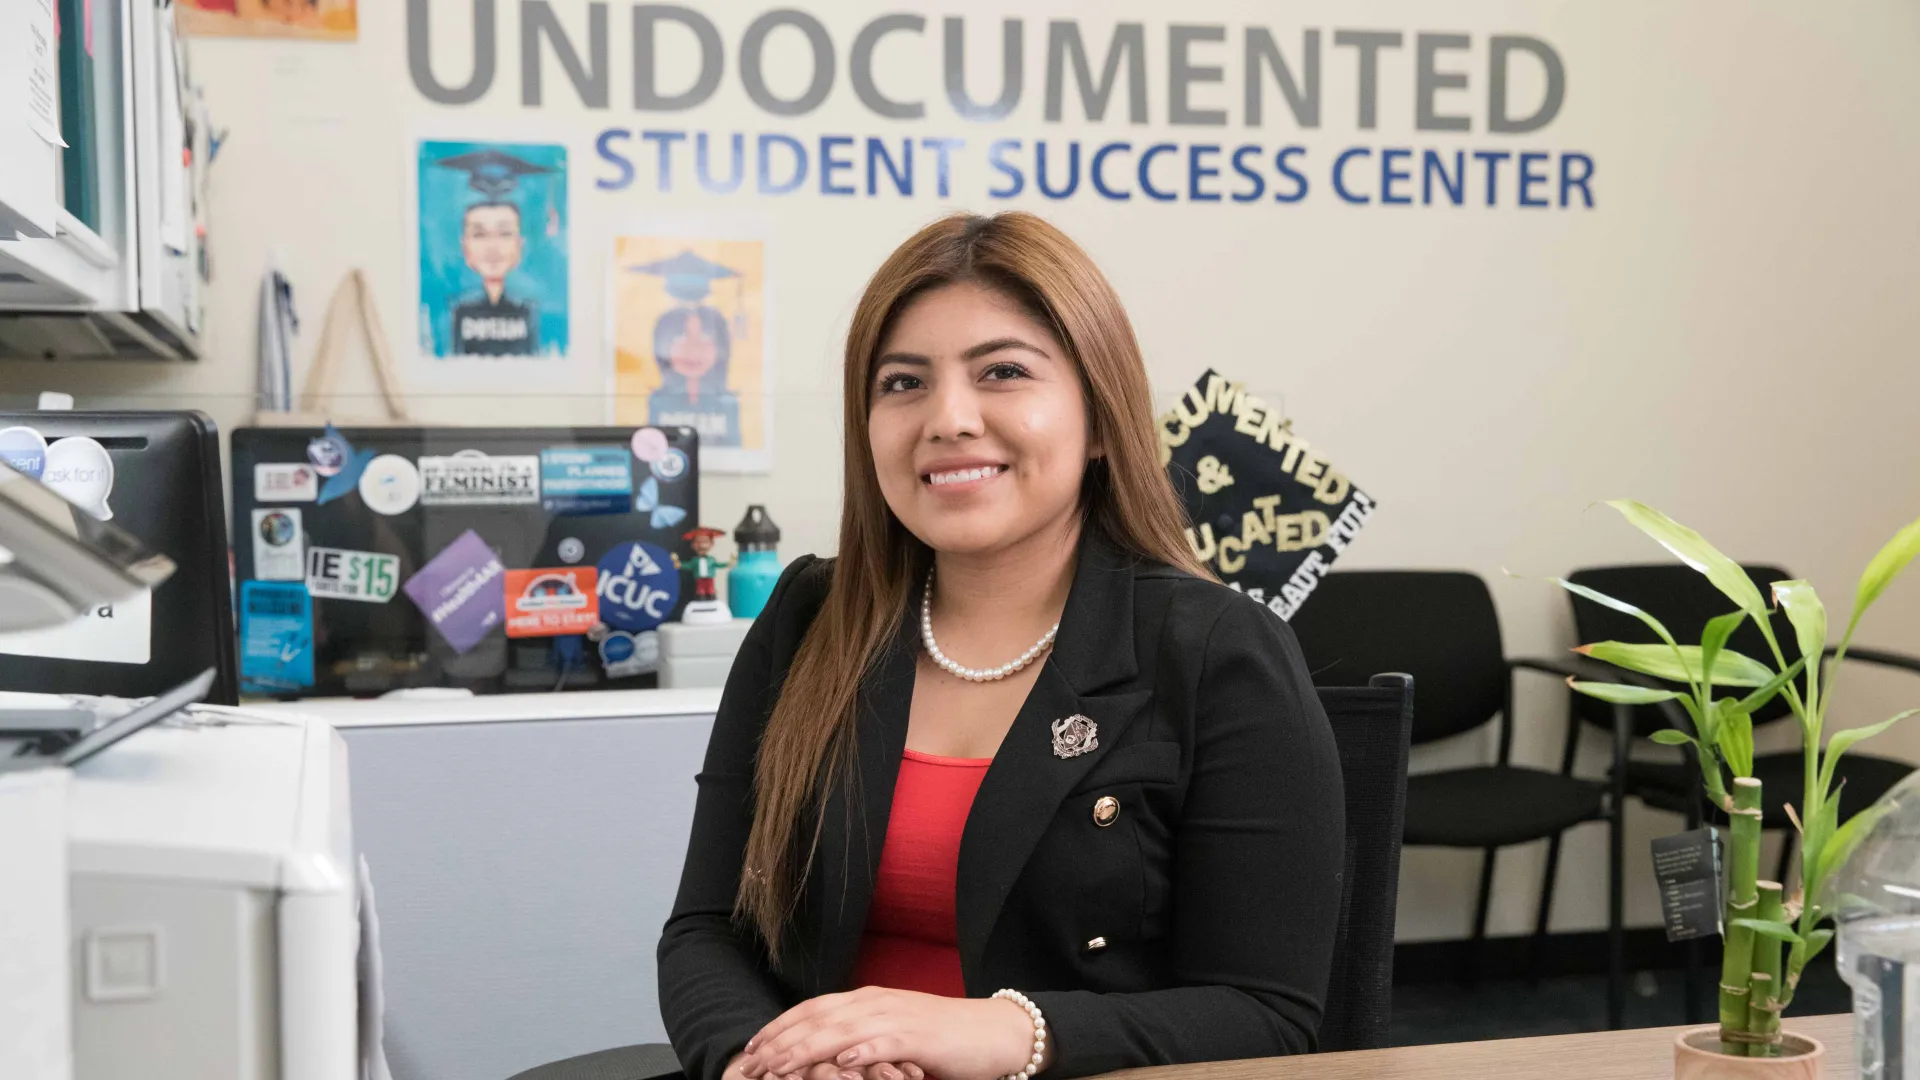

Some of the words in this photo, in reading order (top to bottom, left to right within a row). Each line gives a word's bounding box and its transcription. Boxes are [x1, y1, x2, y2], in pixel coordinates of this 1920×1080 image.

[406, 0, 1567, 135] UNDOCUMENTED
[595, 128, 964, 198] STUDENT
[987, 138, 1309, 203] SUCCESS
[1332, 147, 1597, 208] CENTER
[1158, 374, 1349, 504] CUMENTED
[46, 467, 71, 483] ask
[74, 466, 95, 482] for
[424, 474, 533, 490] FEMINIST
[1197, 455, 1234, 494] &
[312, 552, 341, 579] IE
[348, 556, 392, 597] $15
[596, 569, 671, 619] ICUC
